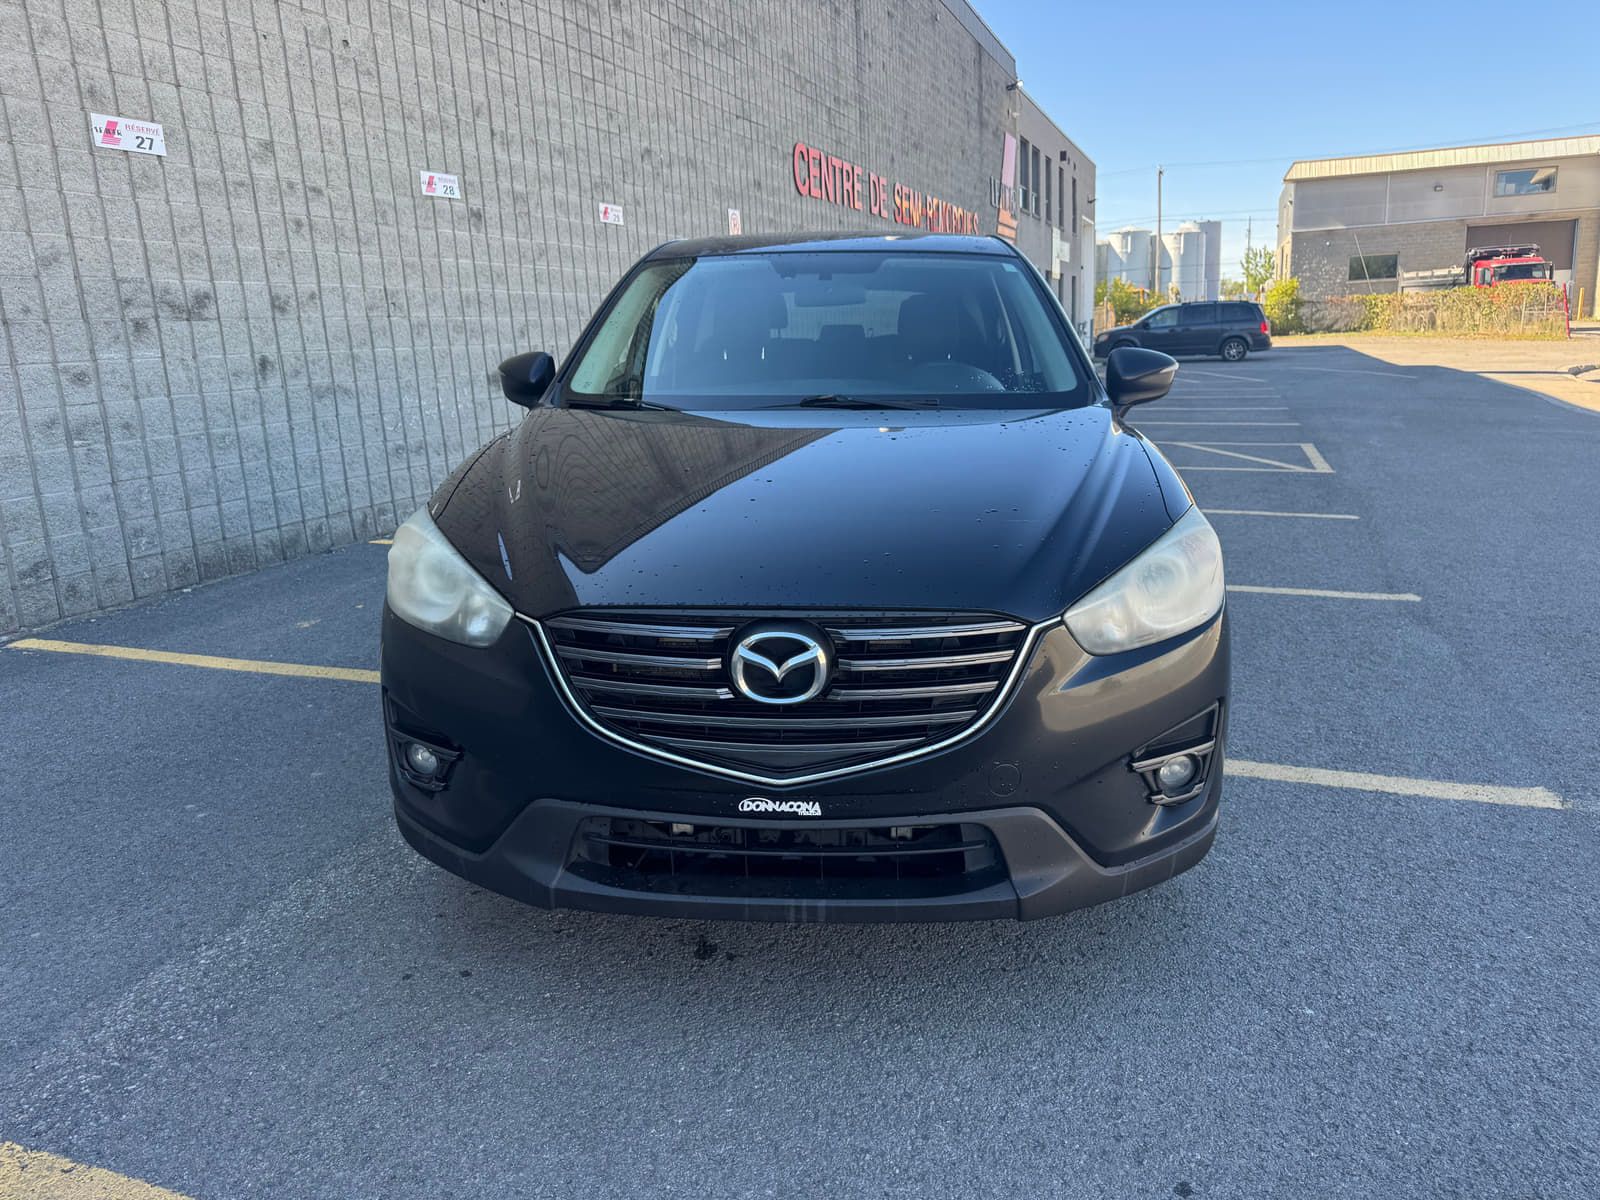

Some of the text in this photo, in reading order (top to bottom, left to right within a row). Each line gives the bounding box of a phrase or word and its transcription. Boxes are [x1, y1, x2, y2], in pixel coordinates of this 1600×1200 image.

[135, 135, 155, 151] 27
[793, 142, 863, 212] CENTRE
[869, 171, 889, 219] DE
[442, 184, 456, 196] 28
